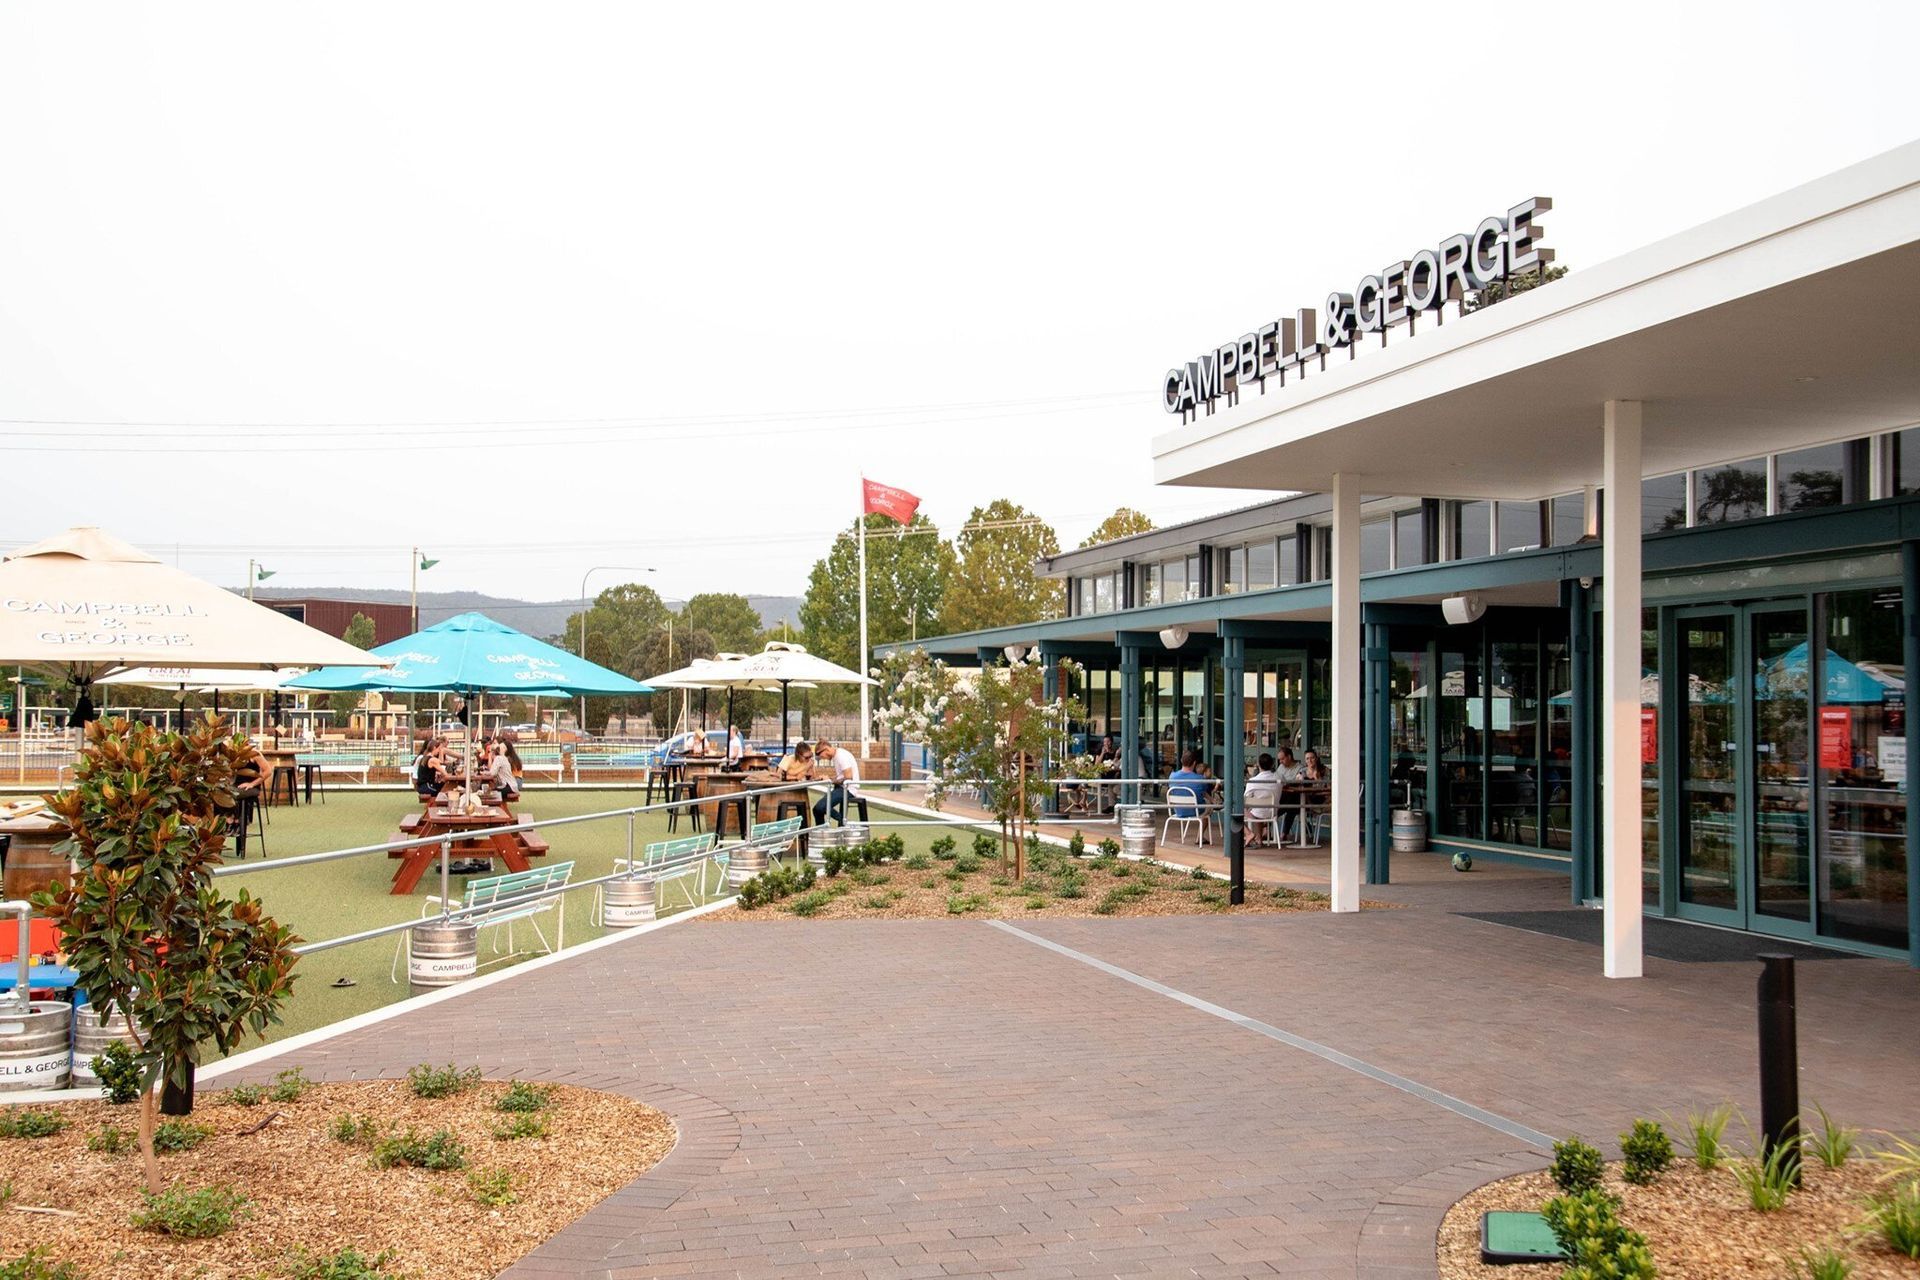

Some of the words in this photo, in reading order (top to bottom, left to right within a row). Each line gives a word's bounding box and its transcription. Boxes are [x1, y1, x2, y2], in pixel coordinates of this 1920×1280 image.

[1163, 308, 1330, 414] CAMPBELL
[1323, 292, 1362, 347] &
[1354, 197, 1555, 332] GEORGE
[4, 597, 208, 617] CAMPBELL
[101, 617, 127, 629] &
[37, 631, 194, 647] GEORGE
[25, 1065, 33, 1074] &
